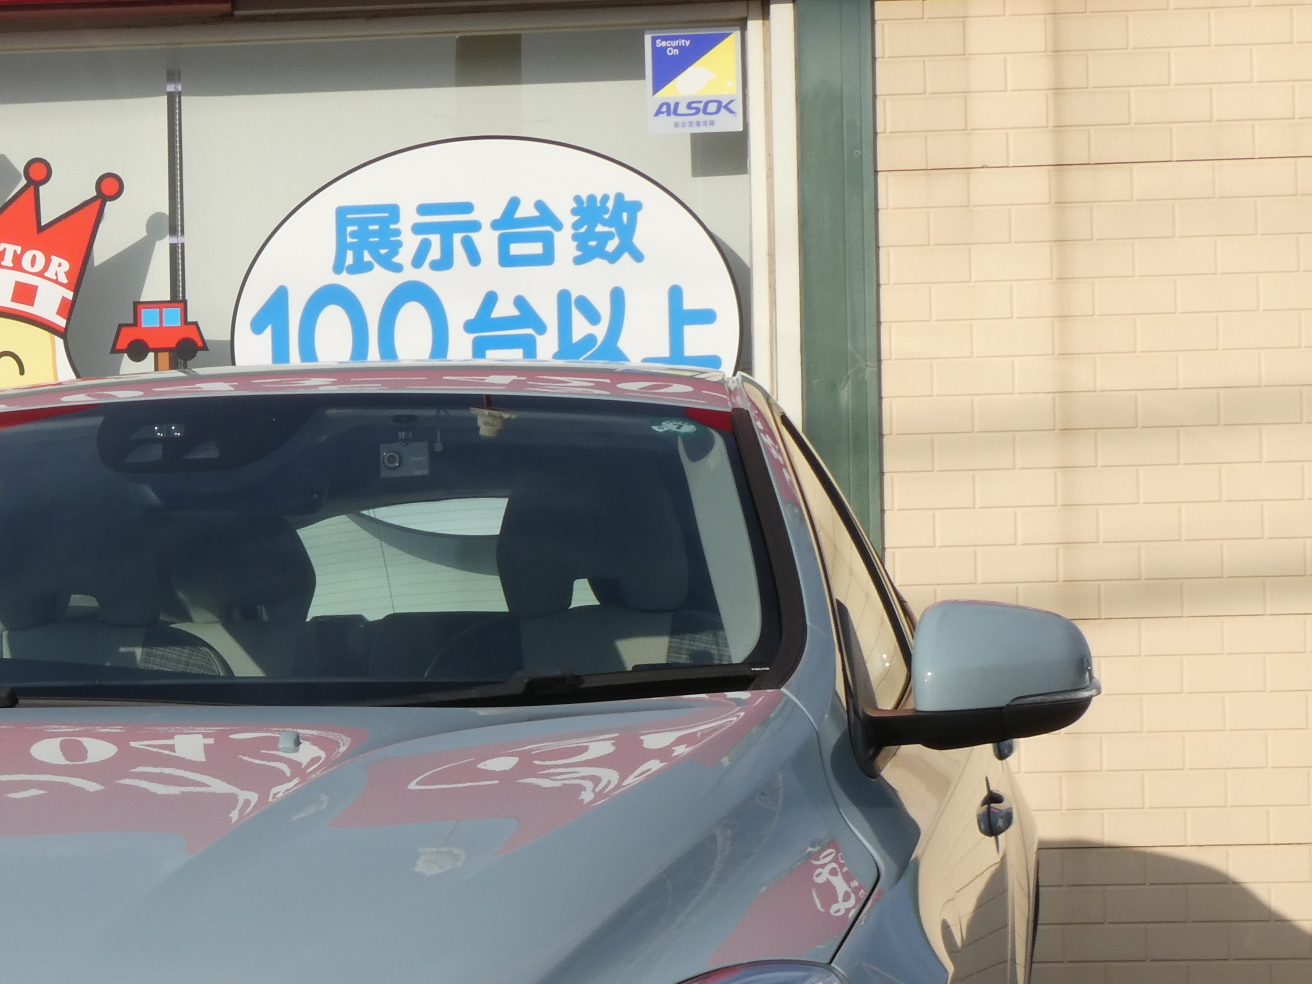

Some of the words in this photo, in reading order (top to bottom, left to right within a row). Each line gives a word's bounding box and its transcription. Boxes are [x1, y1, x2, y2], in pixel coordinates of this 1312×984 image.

[655, 38, 691, 48] Security
[666, 47, 679, 55] On
[653, 99, 736, 117] ALSOK
[332, 192, 645, 275] 展示台数
[250, 280, 722, 370] 100台以上
